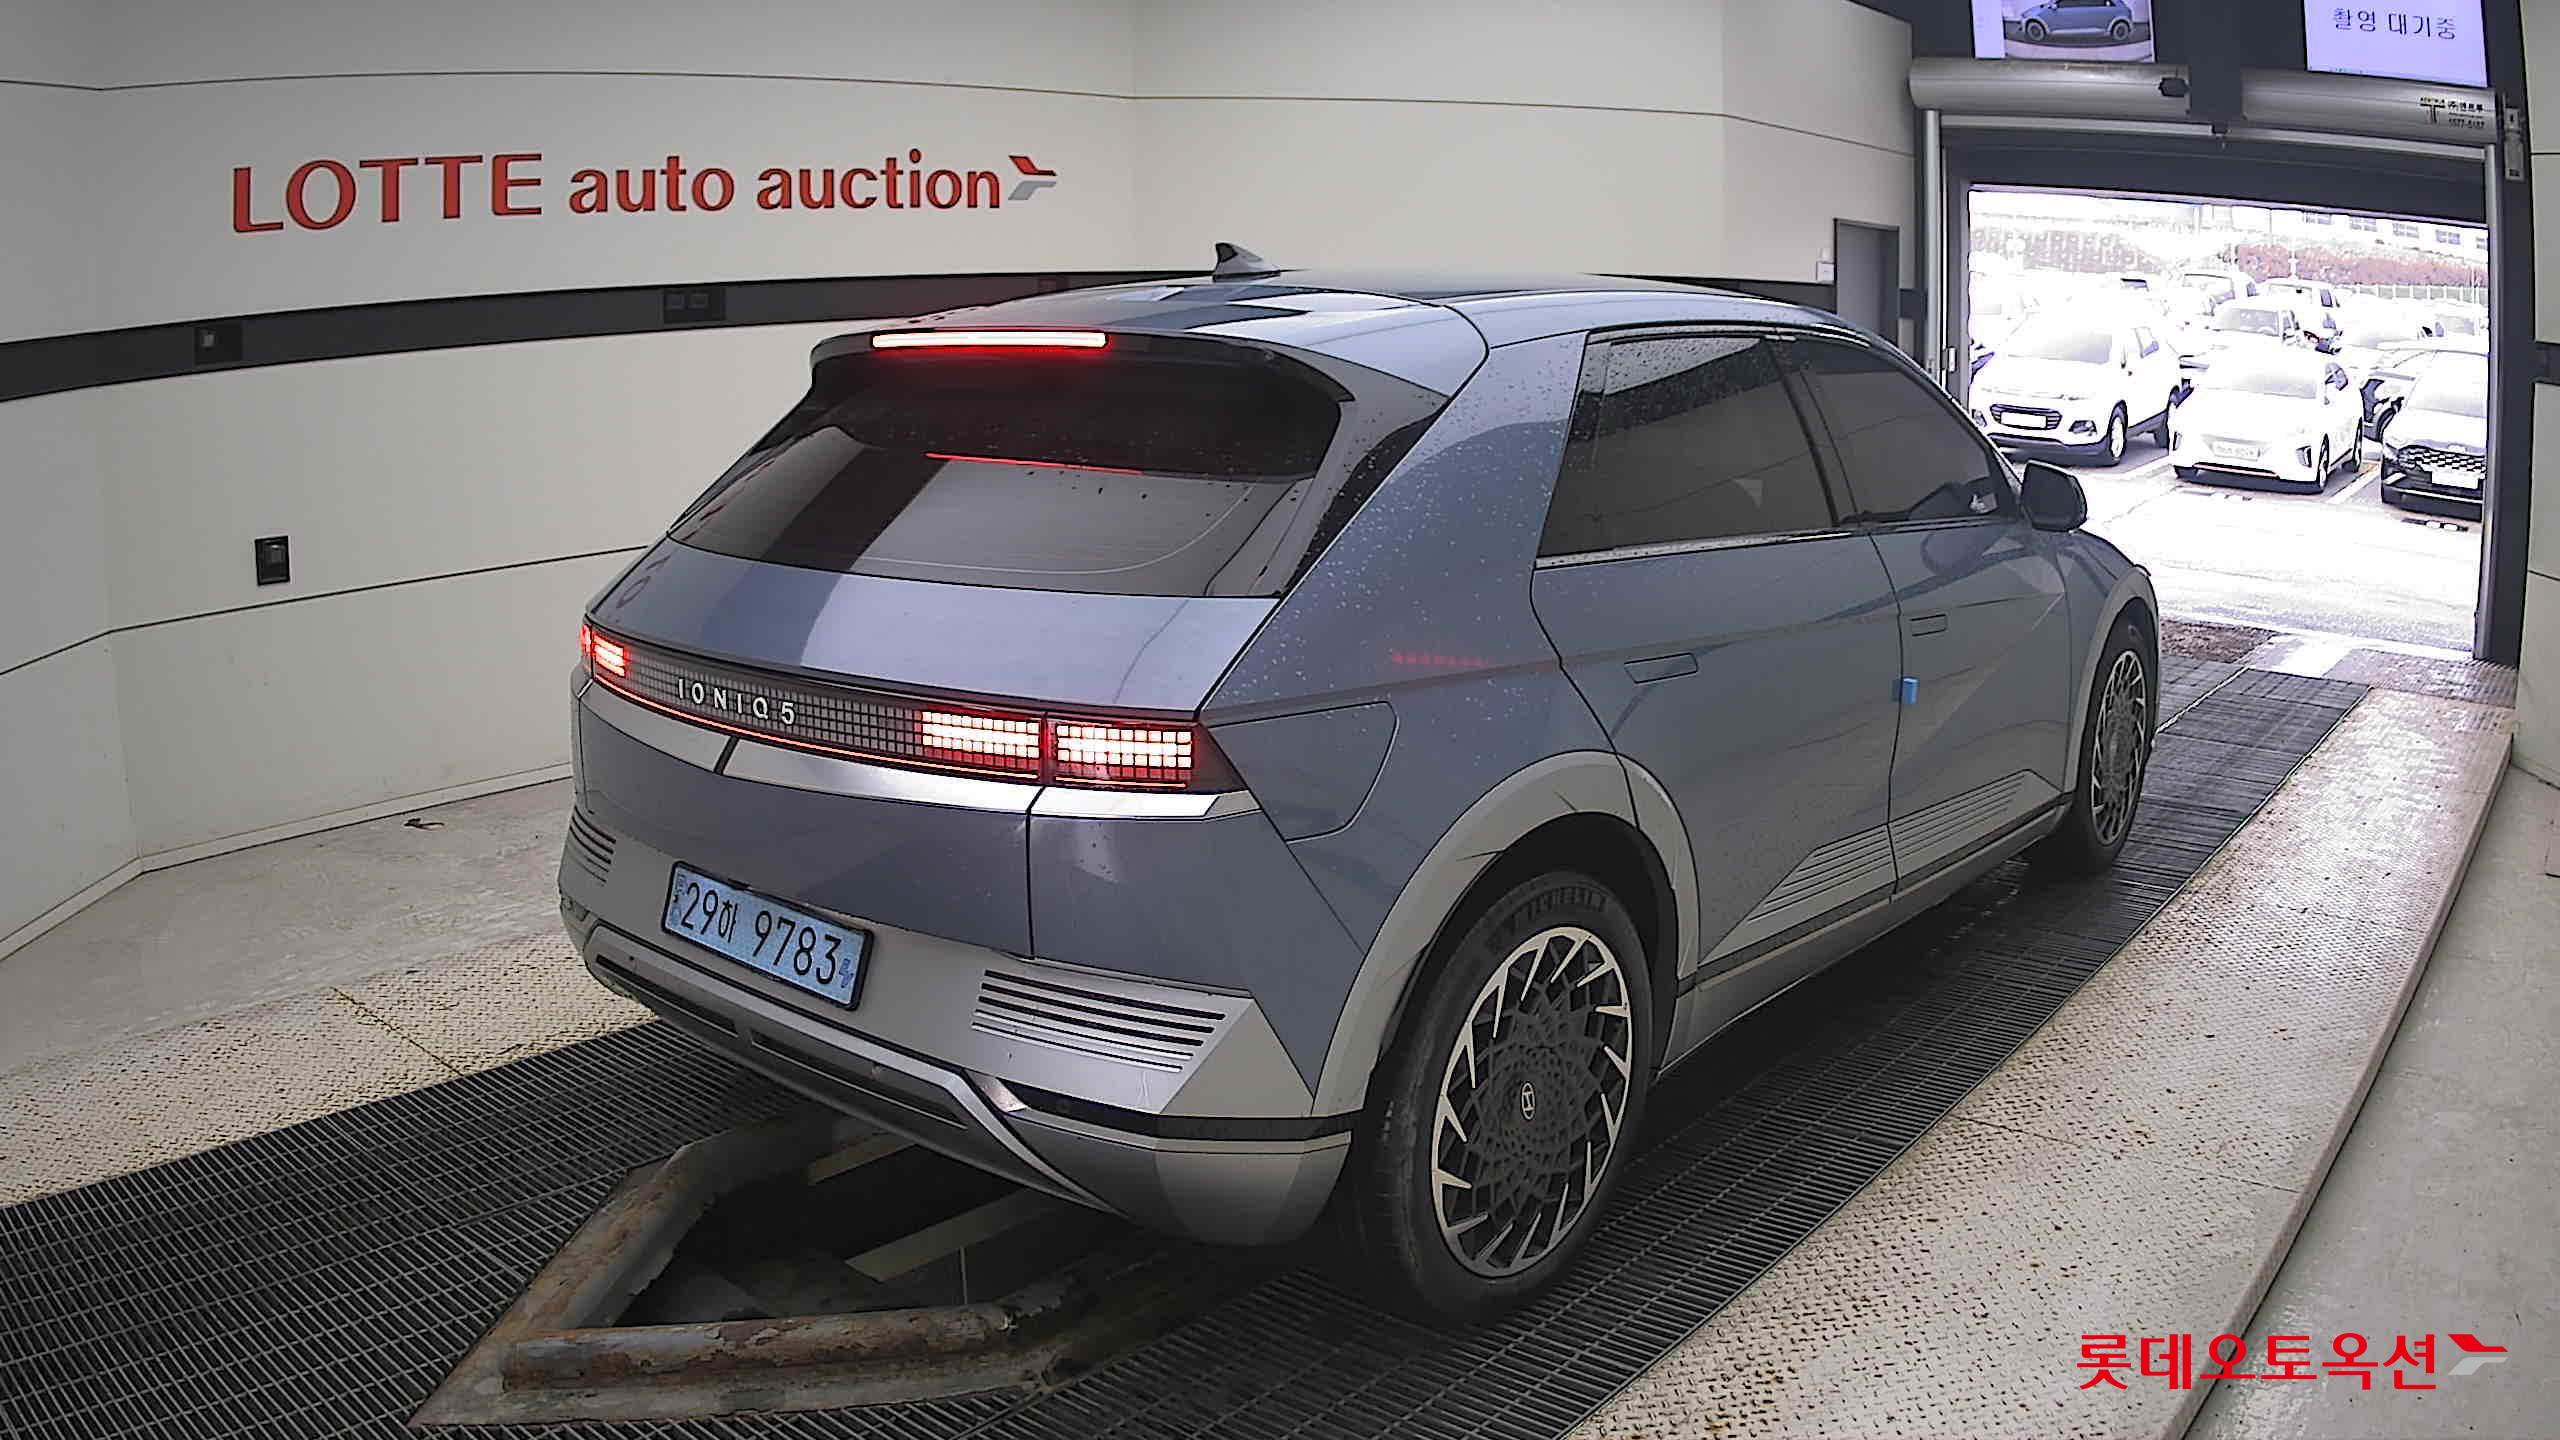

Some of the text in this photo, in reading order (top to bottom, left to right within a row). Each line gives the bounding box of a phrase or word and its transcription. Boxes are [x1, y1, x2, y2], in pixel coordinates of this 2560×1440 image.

[2333, 7, 2457, 40] 촬영 대기중
[233, 148, 1001, 233] LOTTE auto auction
[680, 882, 738, 943] 29하
[752, 910, 841, 985] 9783
